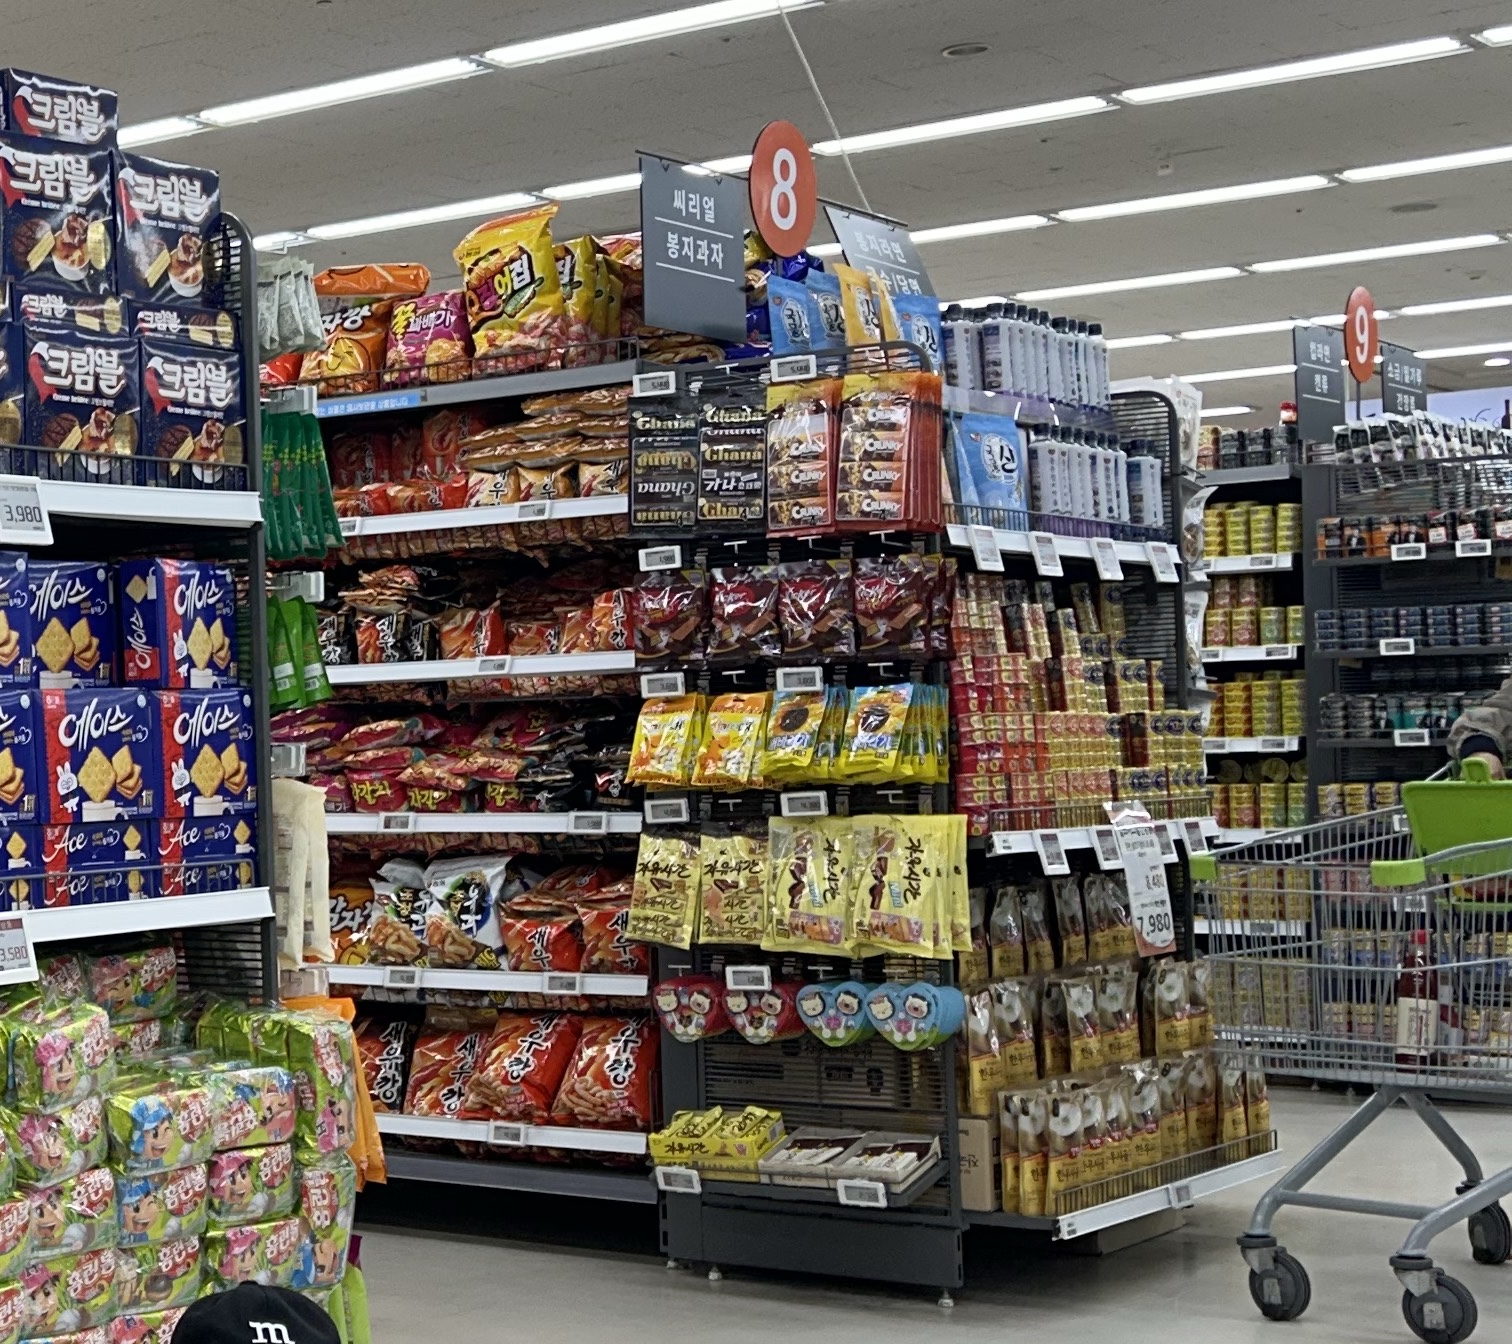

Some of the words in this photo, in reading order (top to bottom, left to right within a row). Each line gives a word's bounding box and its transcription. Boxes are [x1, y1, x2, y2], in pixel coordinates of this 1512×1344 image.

[28, 93, 106, 146] 크림블
[10, 154, 95, 206] 크림블
[129, 175, 211, 225] 크림블
[769, 147, 797, 231] 8
[672, 189, 716, 224] 씨리얼
[666, 231, 724, 270] 봉지과자
[853, 231, 907, 264] 봉지라면
[1355, 306, 1369, 364] 9
[43, 348, 127, 398] 크림블
[159, 360, 234, 410] 크림블
[704, 447, 763, 462] Ghana
[4, 504, 43, 523] 3,980
[174, 570, 224, 620] 에이스
[58, 697, 134, 751] 에이스
[173, 697, 240, 749] 에이스
[42, 824, 88, 863] Ace
[159, 819, 201, 856] Ace
[702, 859, 763, 879] 자유시간
[902, 836, 923, 905] 자유시간
[1136, 912, 1171, 938] 7,980
[374, 1020, 408, 1104] 새우깡
[505, 1010, 562, 1084] 새우깡
[439, 1031, 481, 1115] 새우깡
[664, 1141, 710, 1156] 자유시간
[163, 1166, 208, 1214] 홈런볼
[66, 1248, 116, 1302] 홈런볼
